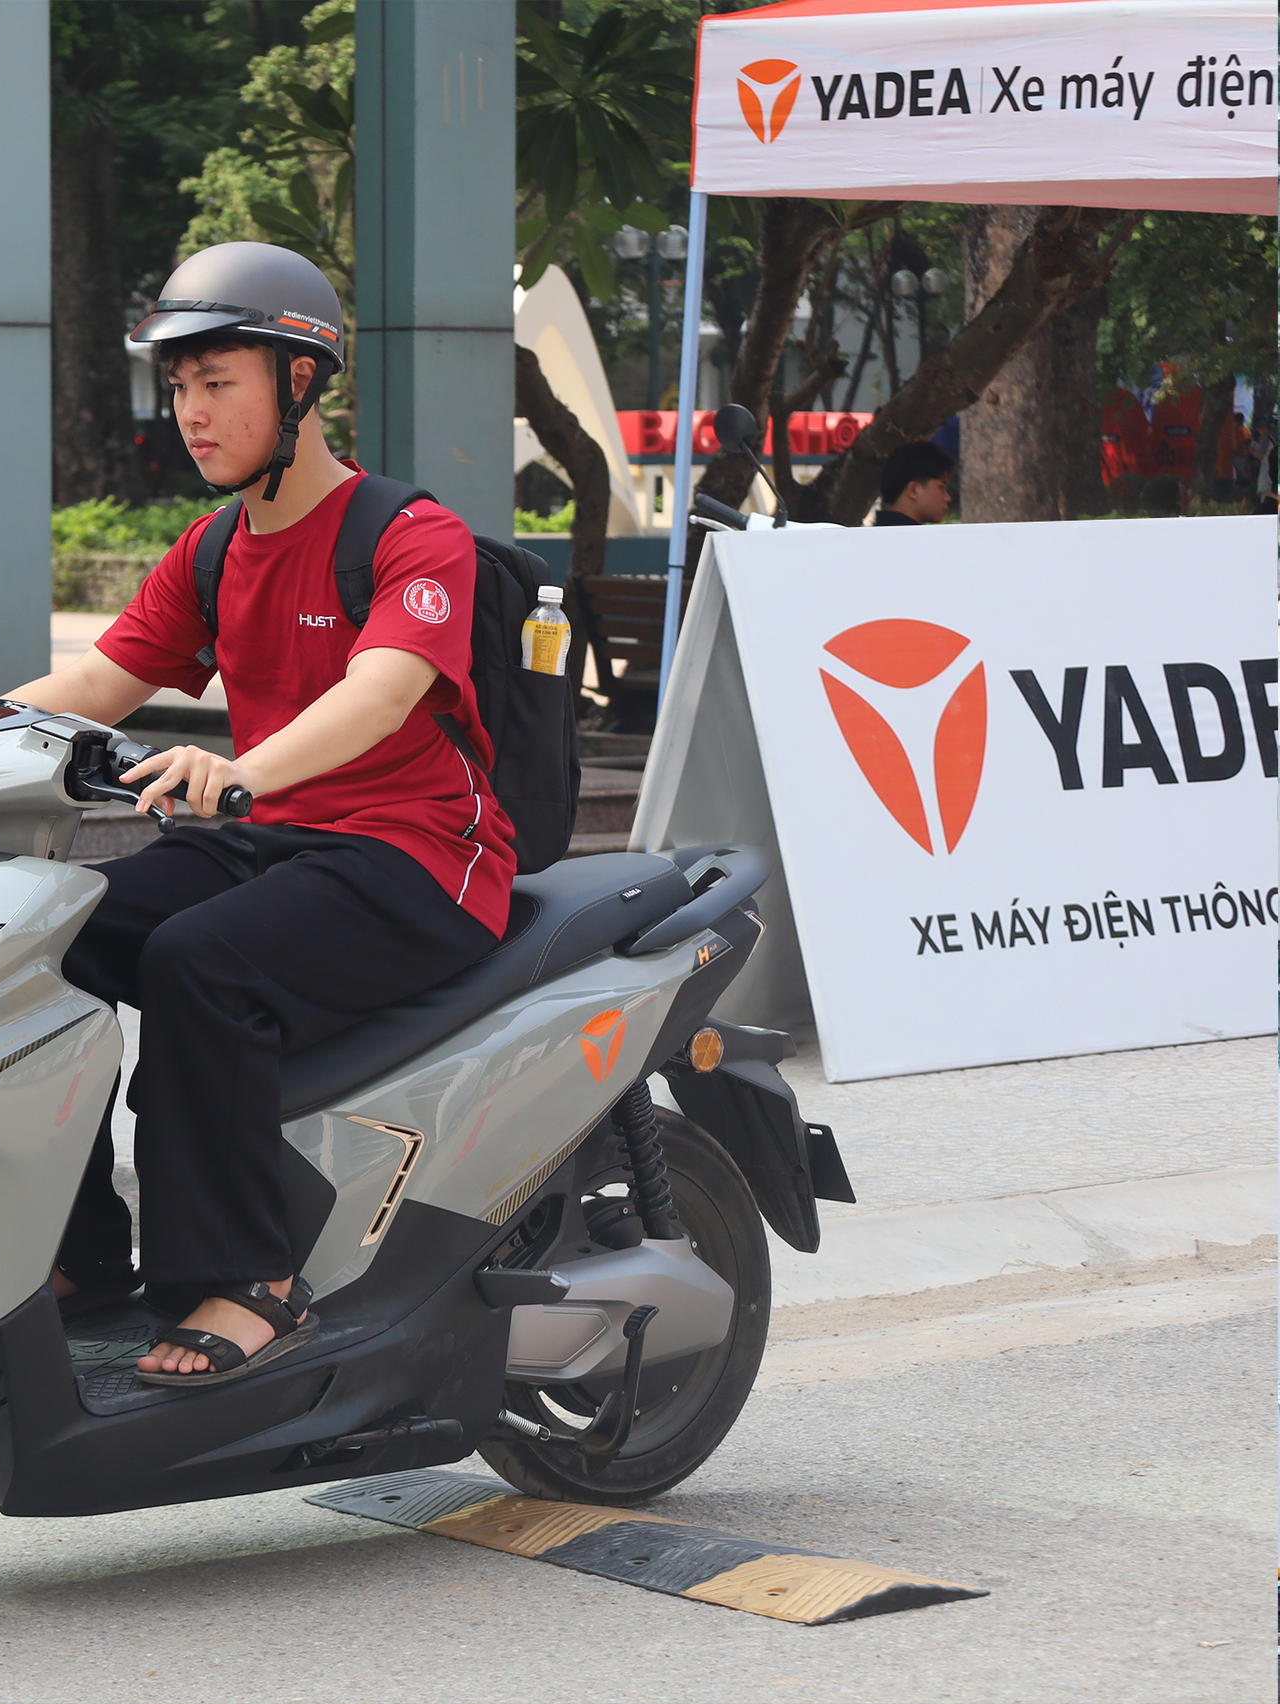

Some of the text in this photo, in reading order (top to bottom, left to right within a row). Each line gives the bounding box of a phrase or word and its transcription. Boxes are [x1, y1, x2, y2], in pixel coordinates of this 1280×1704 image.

[810, 53, 1274, 122] YADEA Xe máy điện
[299, 613, 337, 629] HUST
[910, 914, 964, 956] XE
[971, 898, 1050, 950] MÁY
[1063, 891, 1156, 949] ĐIỆN
[697, 945, 711, 966] H
[485, 1146, 543, 1199] VELAX
